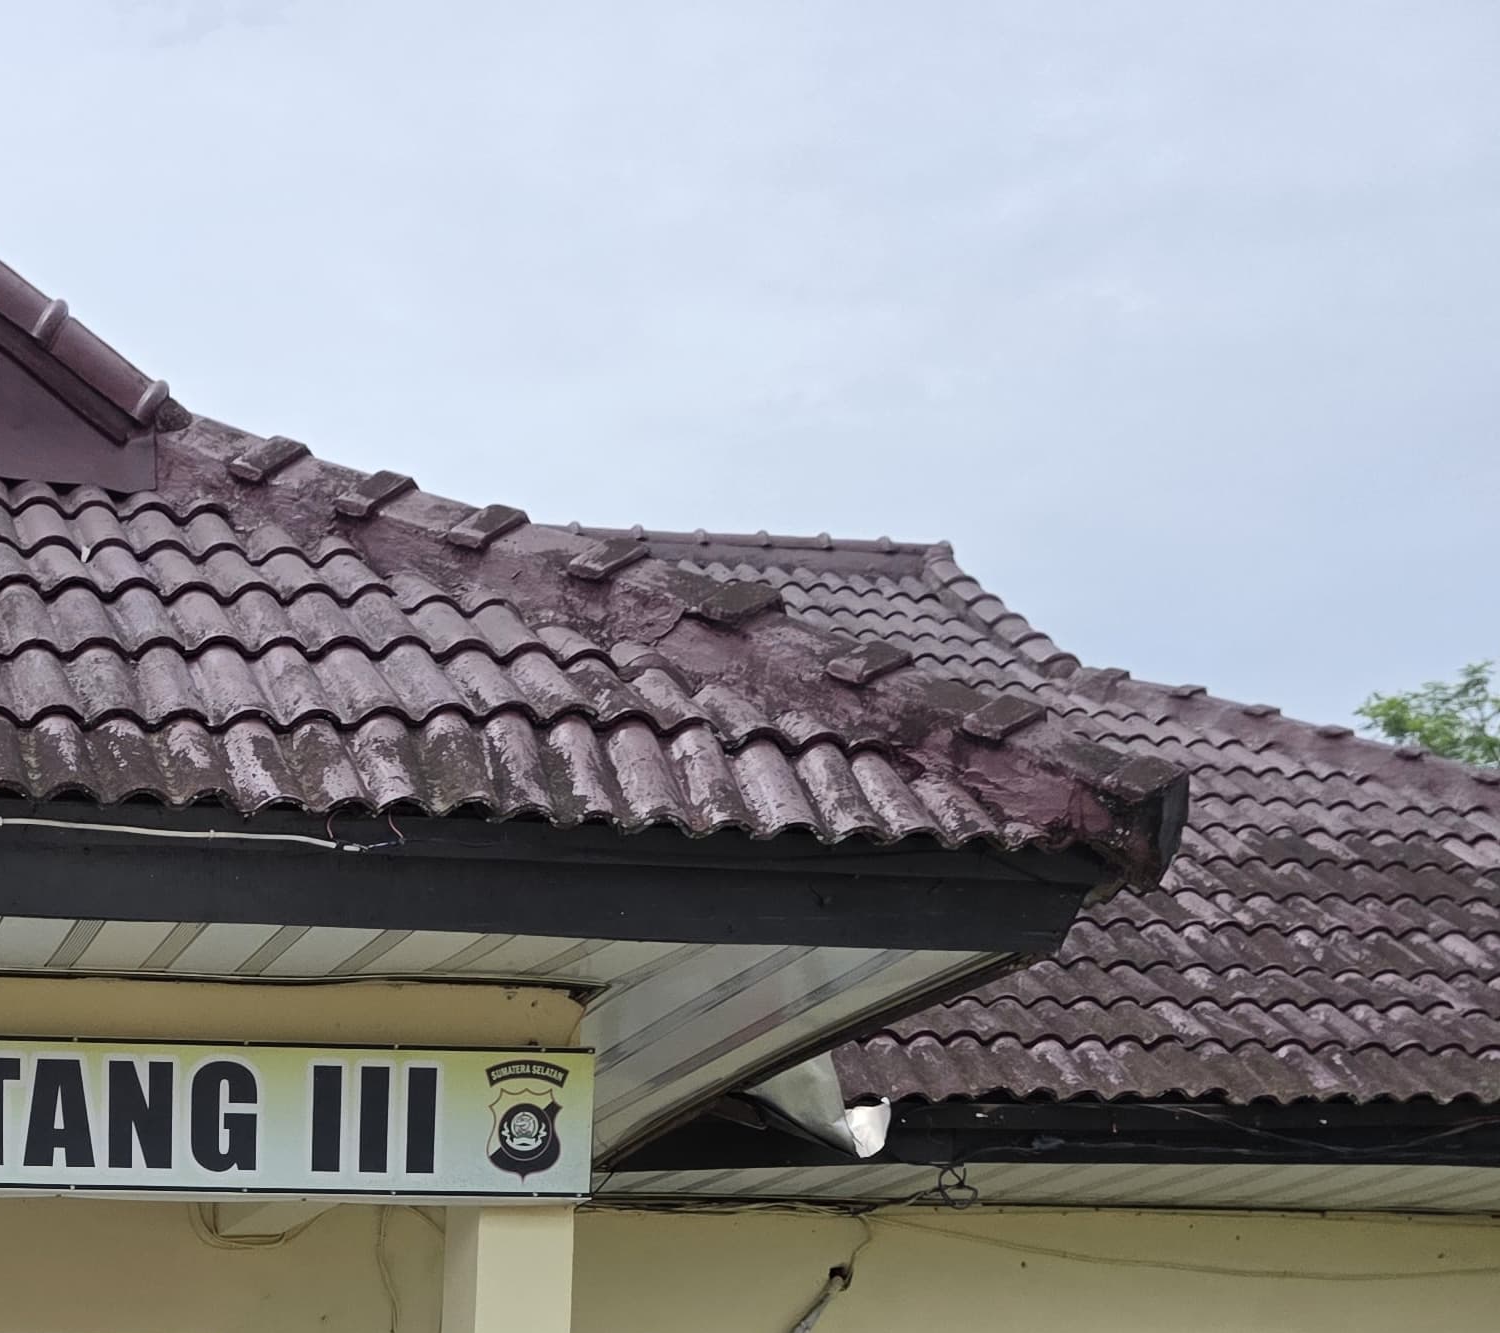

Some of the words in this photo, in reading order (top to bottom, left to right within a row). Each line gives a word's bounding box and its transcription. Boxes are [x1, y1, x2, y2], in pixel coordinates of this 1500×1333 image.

[491, 1064, 531, 1081] SUMATERA
[531, 1064, 565, 1082] SELATAN
[311, 1065, 438, 1175] III
